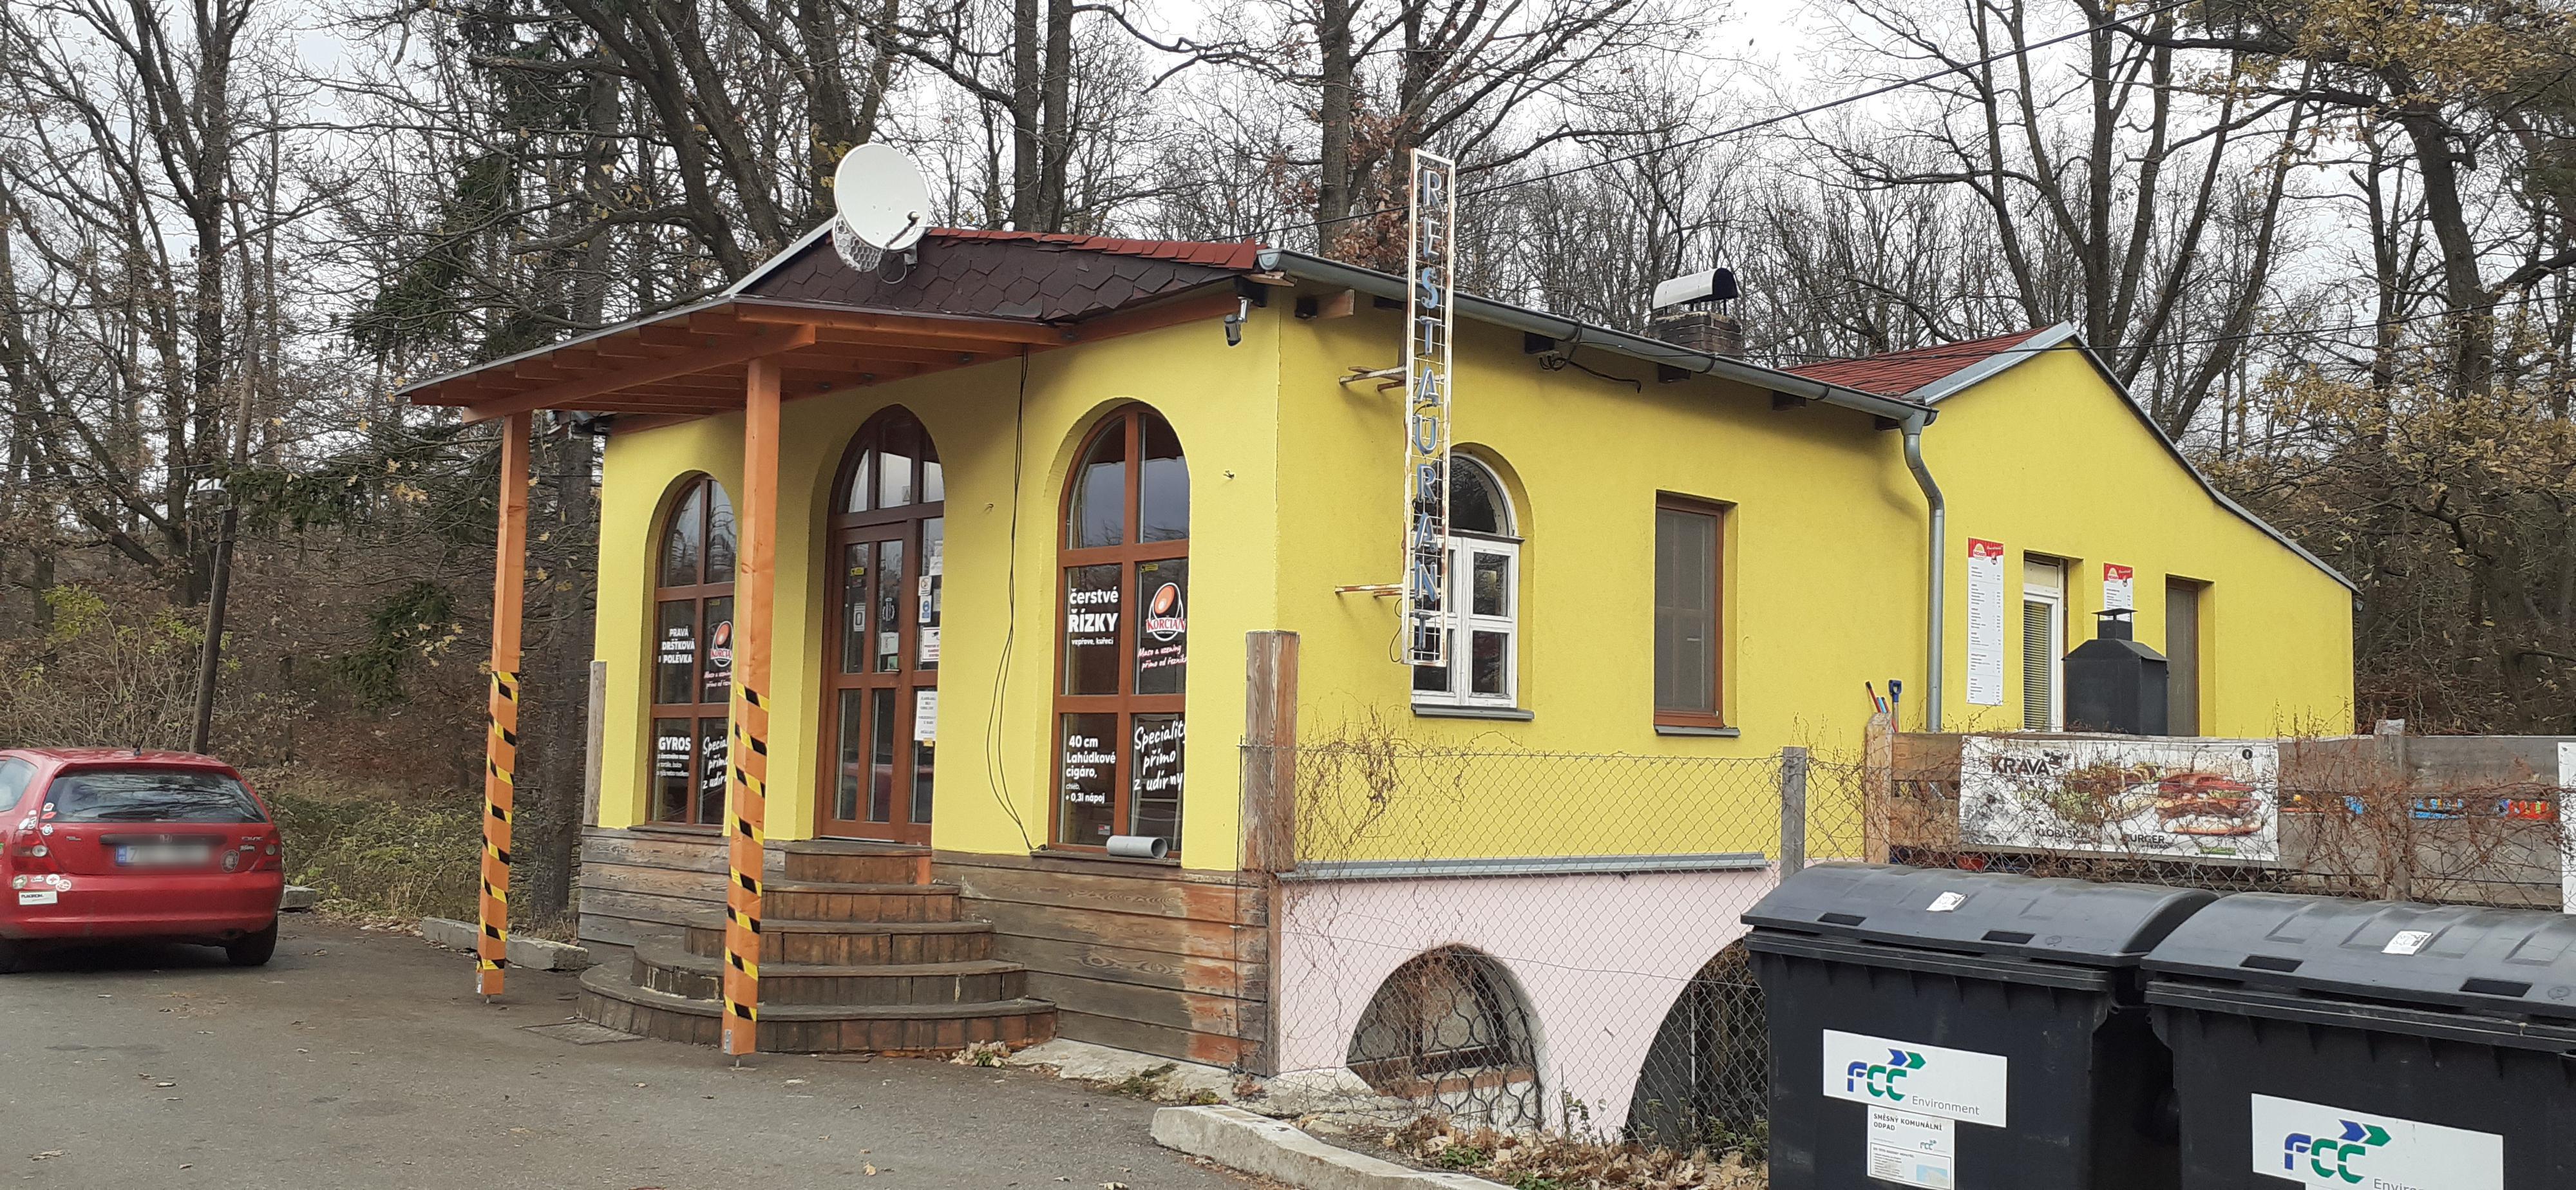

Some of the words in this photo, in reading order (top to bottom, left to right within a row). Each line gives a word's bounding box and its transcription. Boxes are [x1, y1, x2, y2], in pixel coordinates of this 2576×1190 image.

[1414, 169, 1443, 650] RESTAURANT
[1070, 586, 1119, 604] čerstvé
[1068, 609, 1118, 632] ŘÍZKY
[669, 625, 688, 637] PRAVÁ
[662, 638, 695, 650] DRŠŤKOVÁ
[663, 652, 692, 663] POLÉVKA
[659, 736, 691, 751] GYROS
[1069, 735, 1082, 748] 40
[1083, 738, 1099, 748] cm
[1066, 751, 1116, 764] Lahůdkové
[1143, 748, 1177, 776] přímo
[1066, 766, 1098, 780] cigáro,
[703, 779, 708, 789] z
[1133, 779, 1142, 791] z
[1146, 770, 1184, 791] udírny
[1085, 792, 1106, 804] nápoj
[2124, 834, 2165, 844] URGER
[1847, 1061, 1908, 1101] FCC
[1911, 1095, 1980, 1115] Environment
[1873, 1113, 1899, 1124] SMĚSNÝ
[1900, 1118, 1943, 1131] KOMUNÁLNÍ
[1873, 1122, 1895, 1131] ODPAD
[2284, 1133, 2366, 1184] FCC
